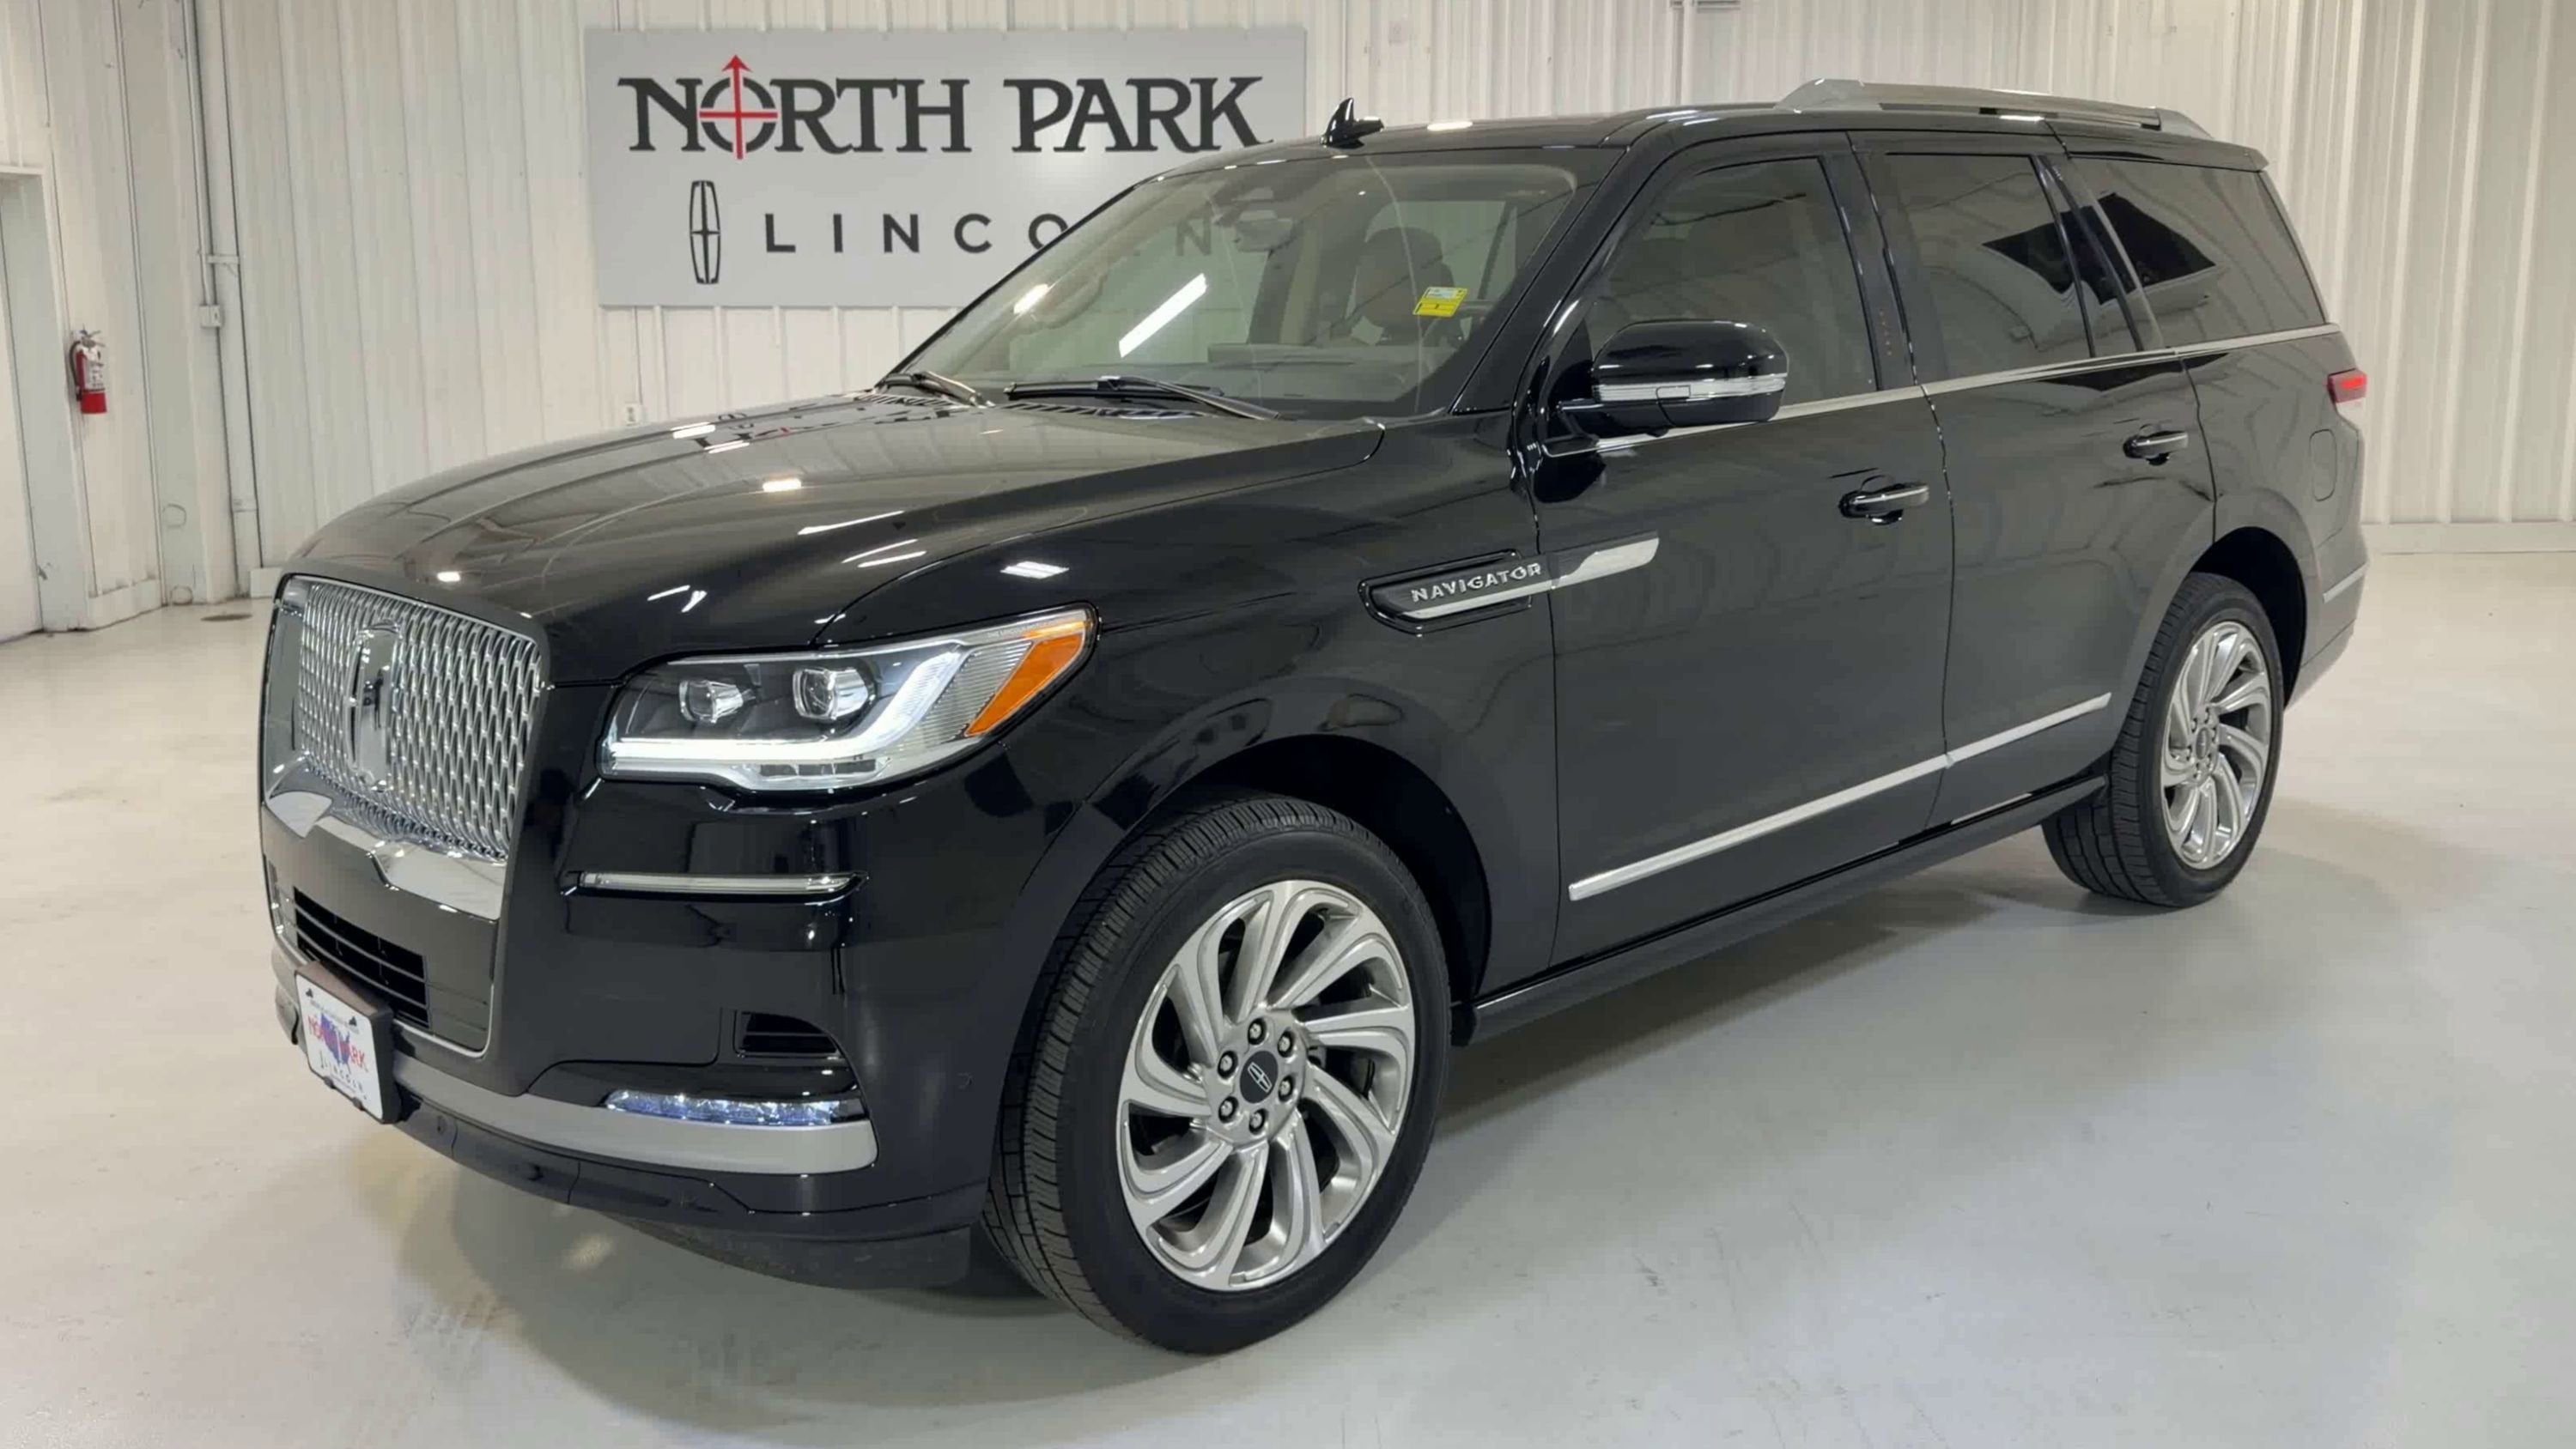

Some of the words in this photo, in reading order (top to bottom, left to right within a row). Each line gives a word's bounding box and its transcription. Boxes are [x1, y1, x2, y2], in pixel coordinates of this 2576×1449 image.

[617, 77, 972, 154] NORTH
[1003, 76, 1274, 153] PARK
[765, 212, 1212, 256] LINCON
[1412, 562, 1542, 603] NAVIGATOR
